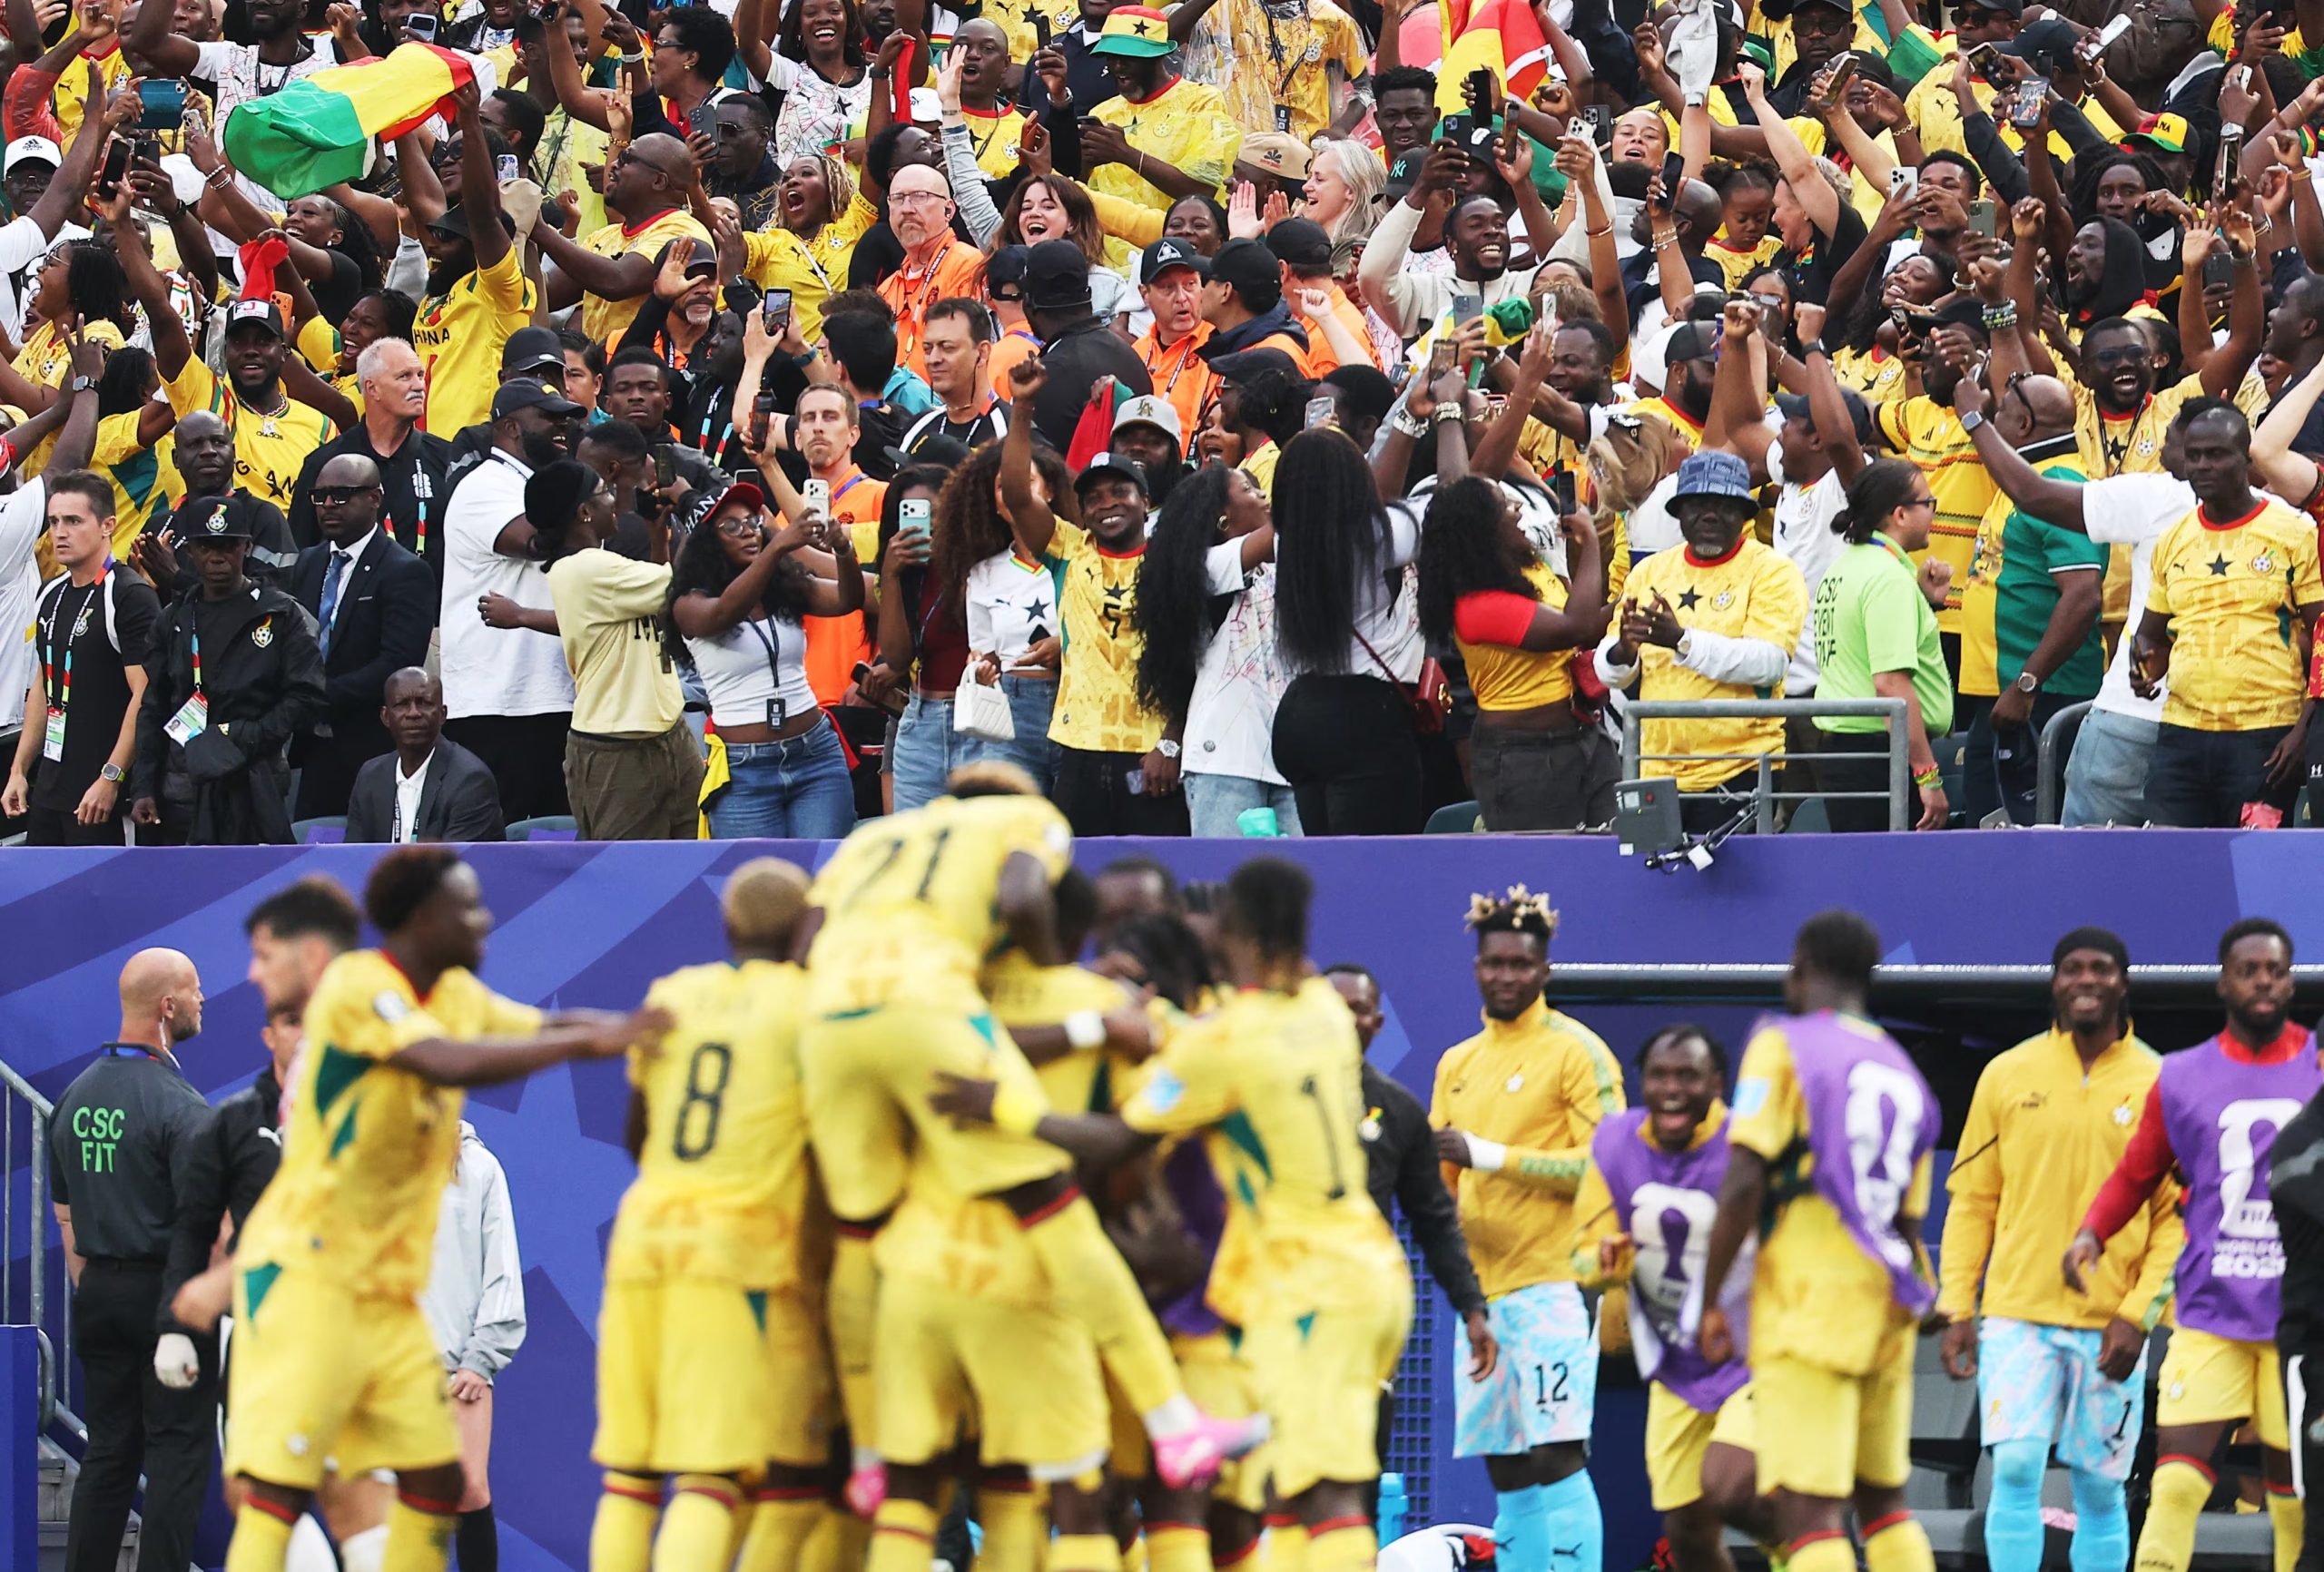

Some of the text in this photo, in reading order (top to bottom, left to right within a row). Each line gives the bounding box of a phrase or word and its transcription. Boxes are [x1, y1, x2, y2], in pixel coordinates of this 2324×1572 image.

[1817, 576, 1842, 604] CSC
[1103, 603, 1121, 640] 5
[672, 1041, 733, 1158] 8
[73, 1106, 125, 1140] CSC
[82, 1141, 116, 1173] FIT
[1535, 1362, 1569, 1405] 12
[2111, 1400, 2132, 1440] 1
